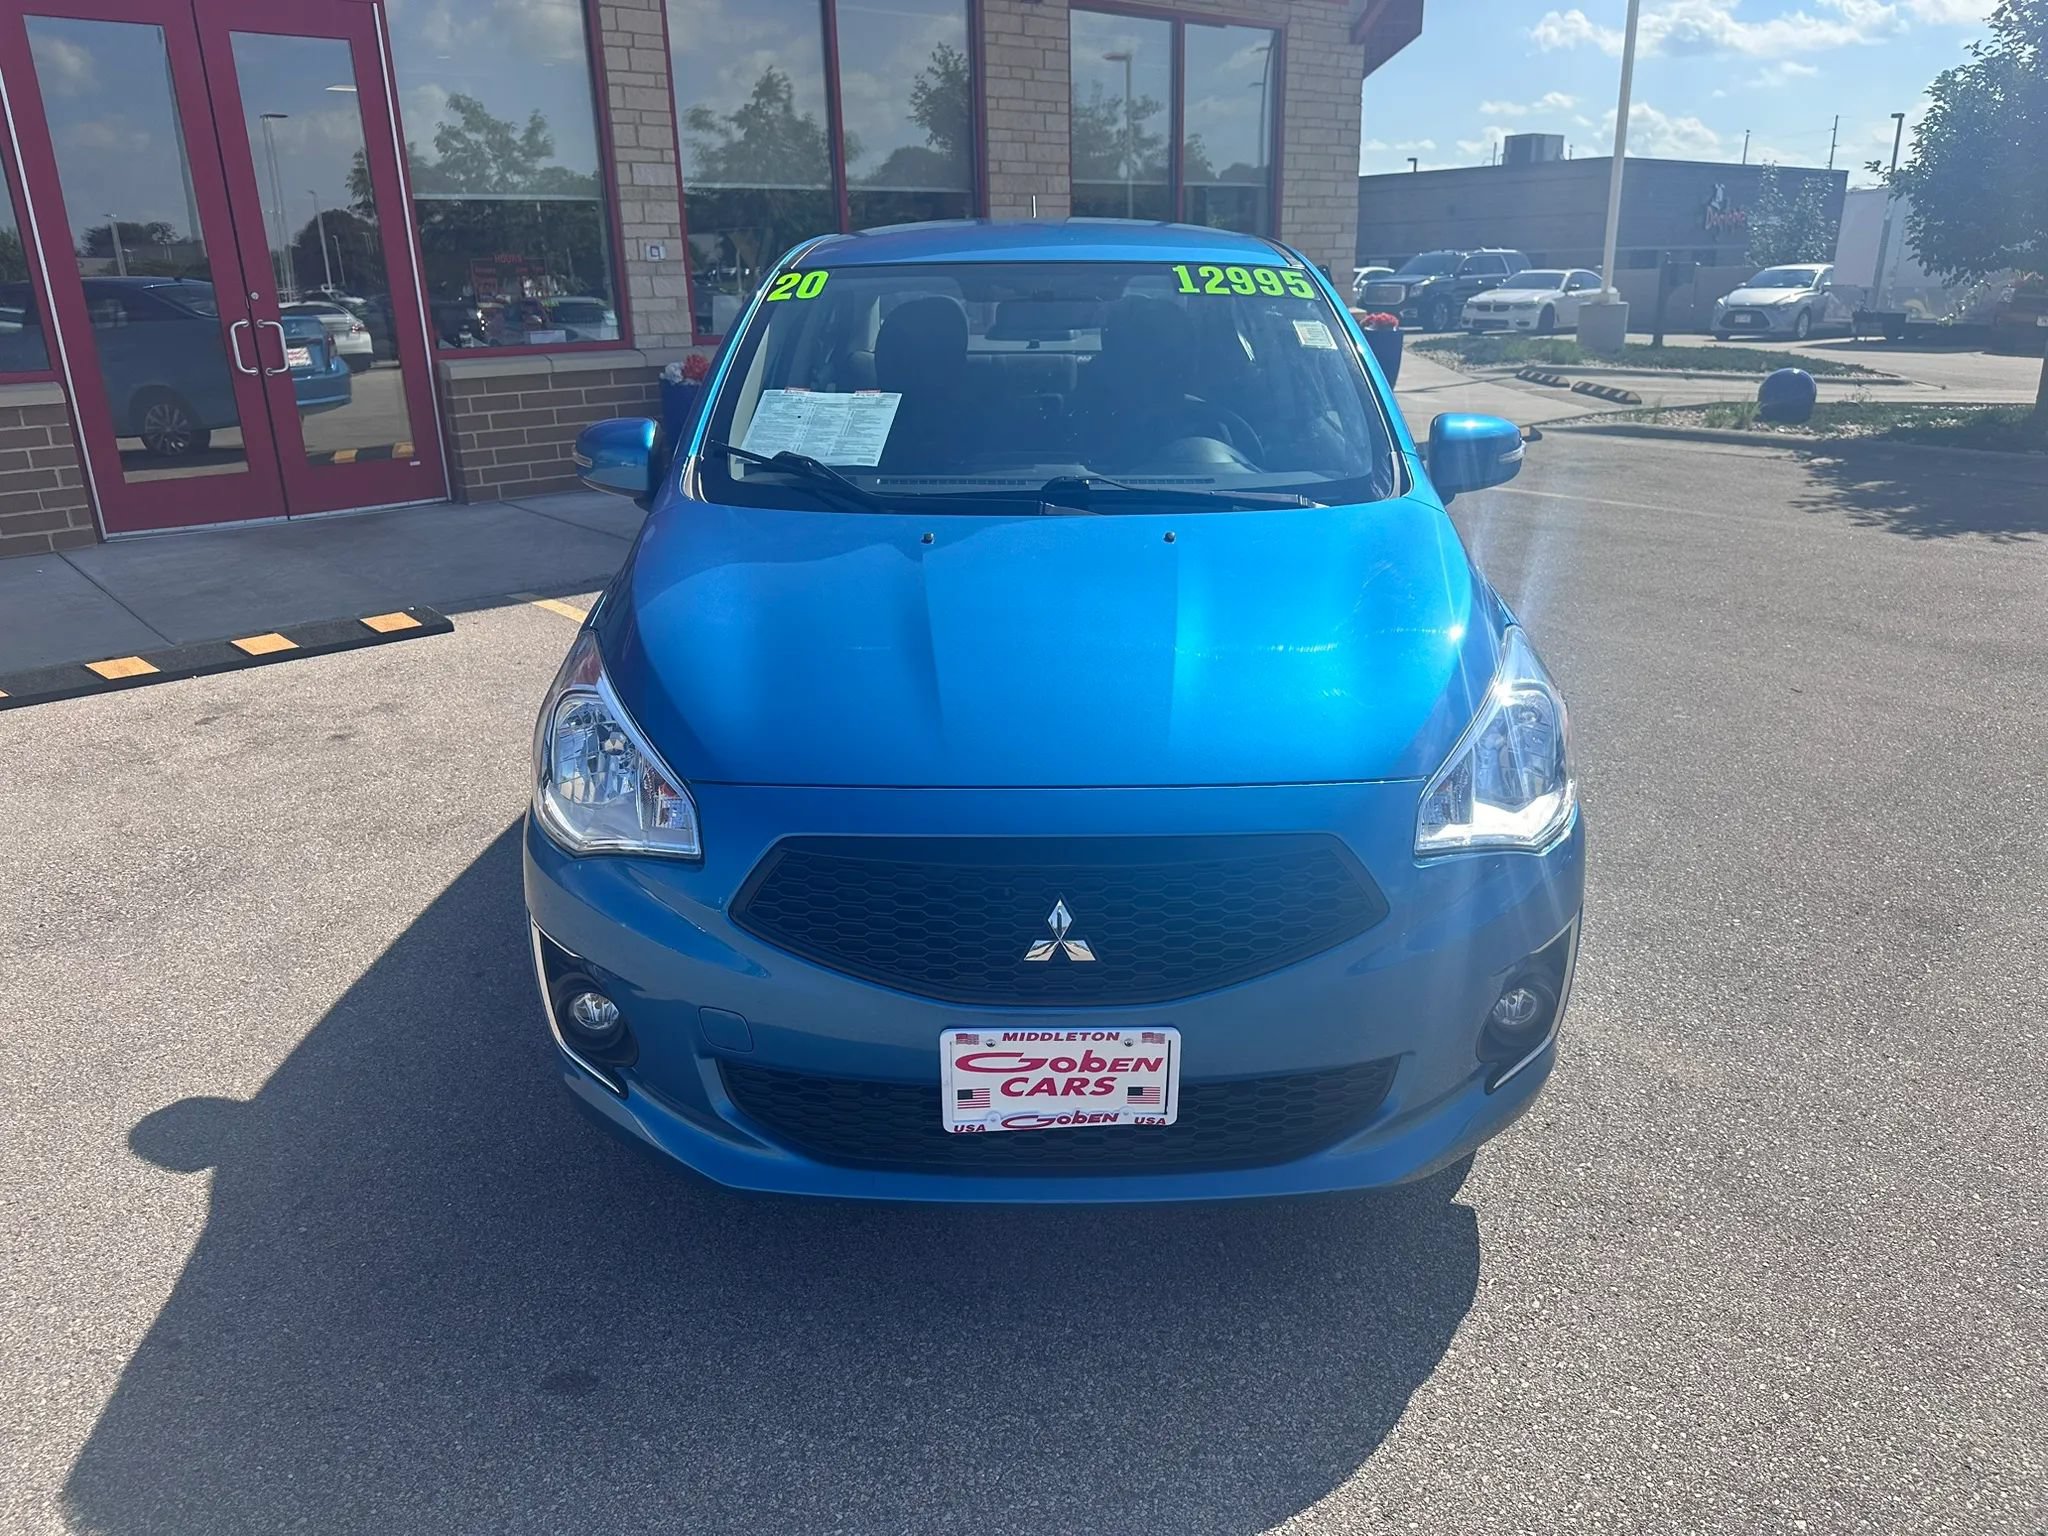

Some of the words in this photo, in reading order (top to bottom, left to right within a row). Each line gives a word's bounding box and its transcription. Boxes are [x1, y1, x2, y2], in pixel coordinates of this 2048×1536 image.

[767, 271, 829, 301] 20
[1172, 265, 1315, 299] 12995
[1002, 1032, 1120, 1041] MIDDLETON
[1000, 1077, 1117, 1096] CARS
[1134, 1117, 1166, 1125] USA
[954, 1124, 986, 1133] USA
